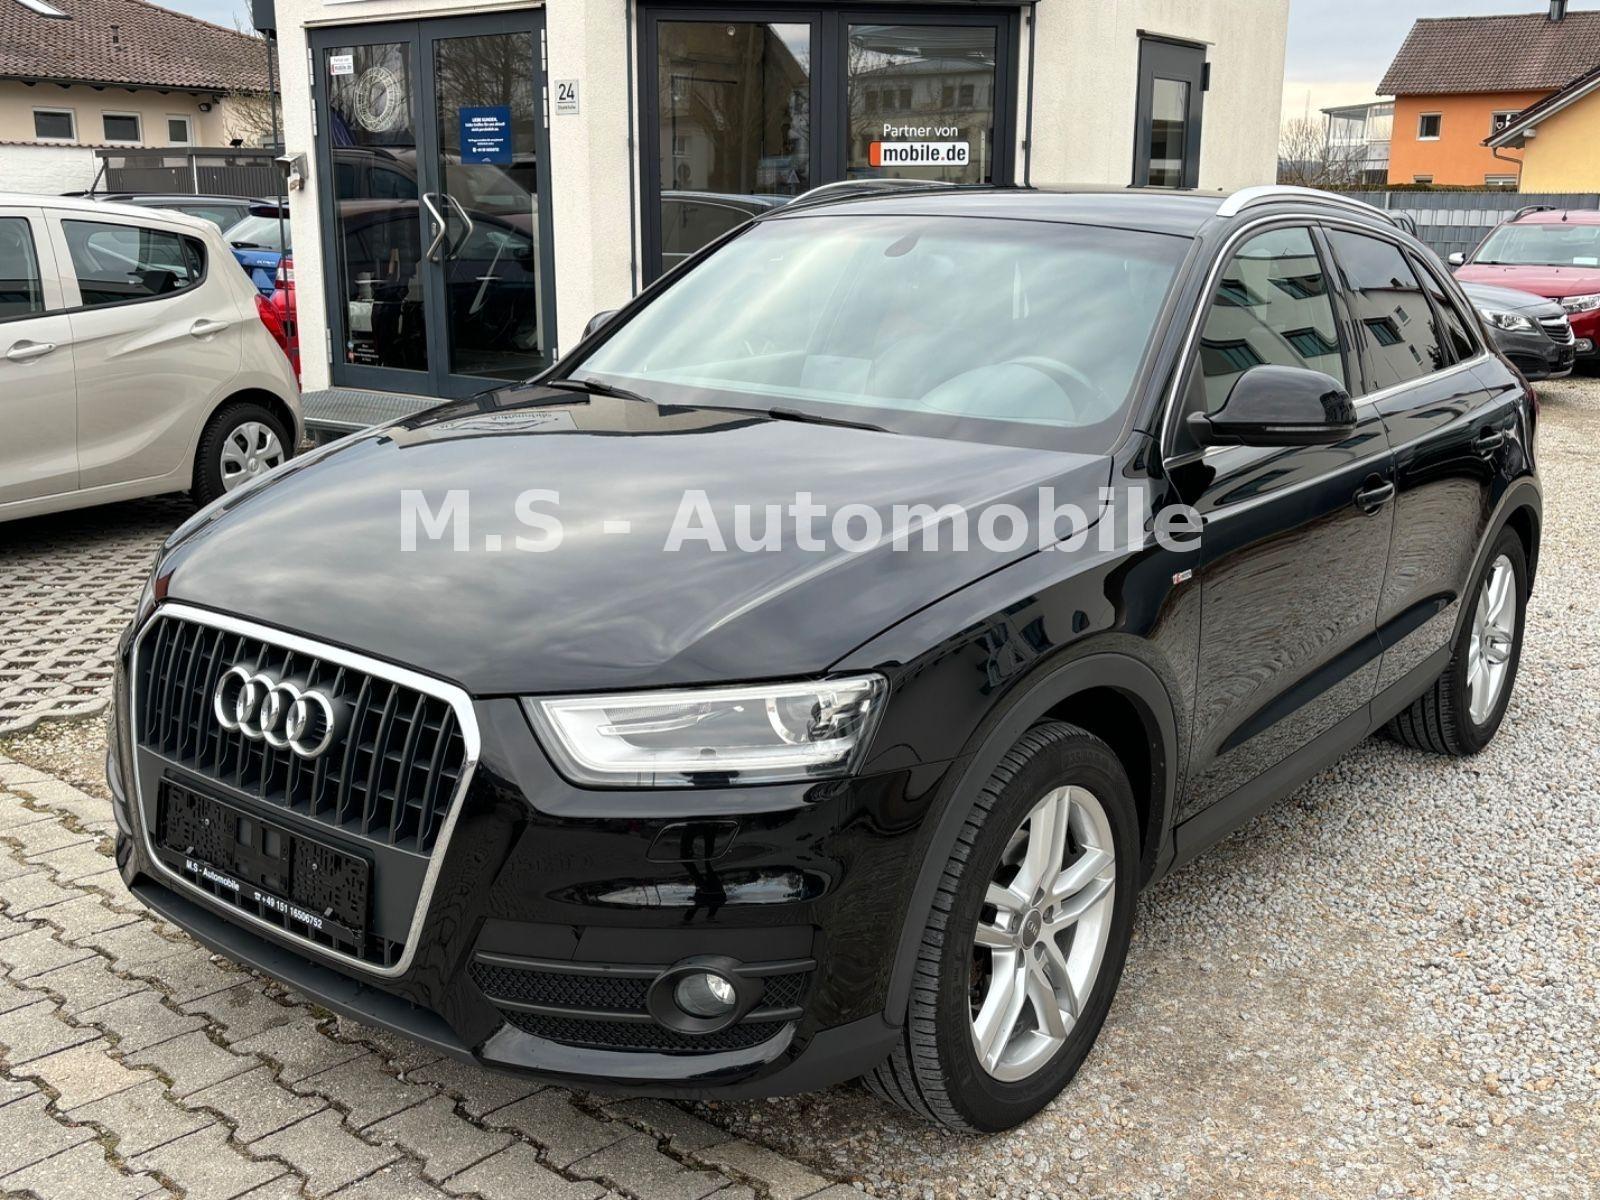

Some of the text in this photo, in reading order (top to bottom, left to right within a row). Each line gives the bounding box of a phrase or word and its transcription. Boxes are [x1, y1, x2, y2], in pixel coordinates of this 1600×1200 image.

[558, 83, 575, 101] 24
[883, 124, 958, 137] Partner von
[883, 144, 966, 161] mobile.de
[186, 859, 199, 872] M.S
[203, 867, 240, 892] Automobile
[276, 900, 288, 914] 151
